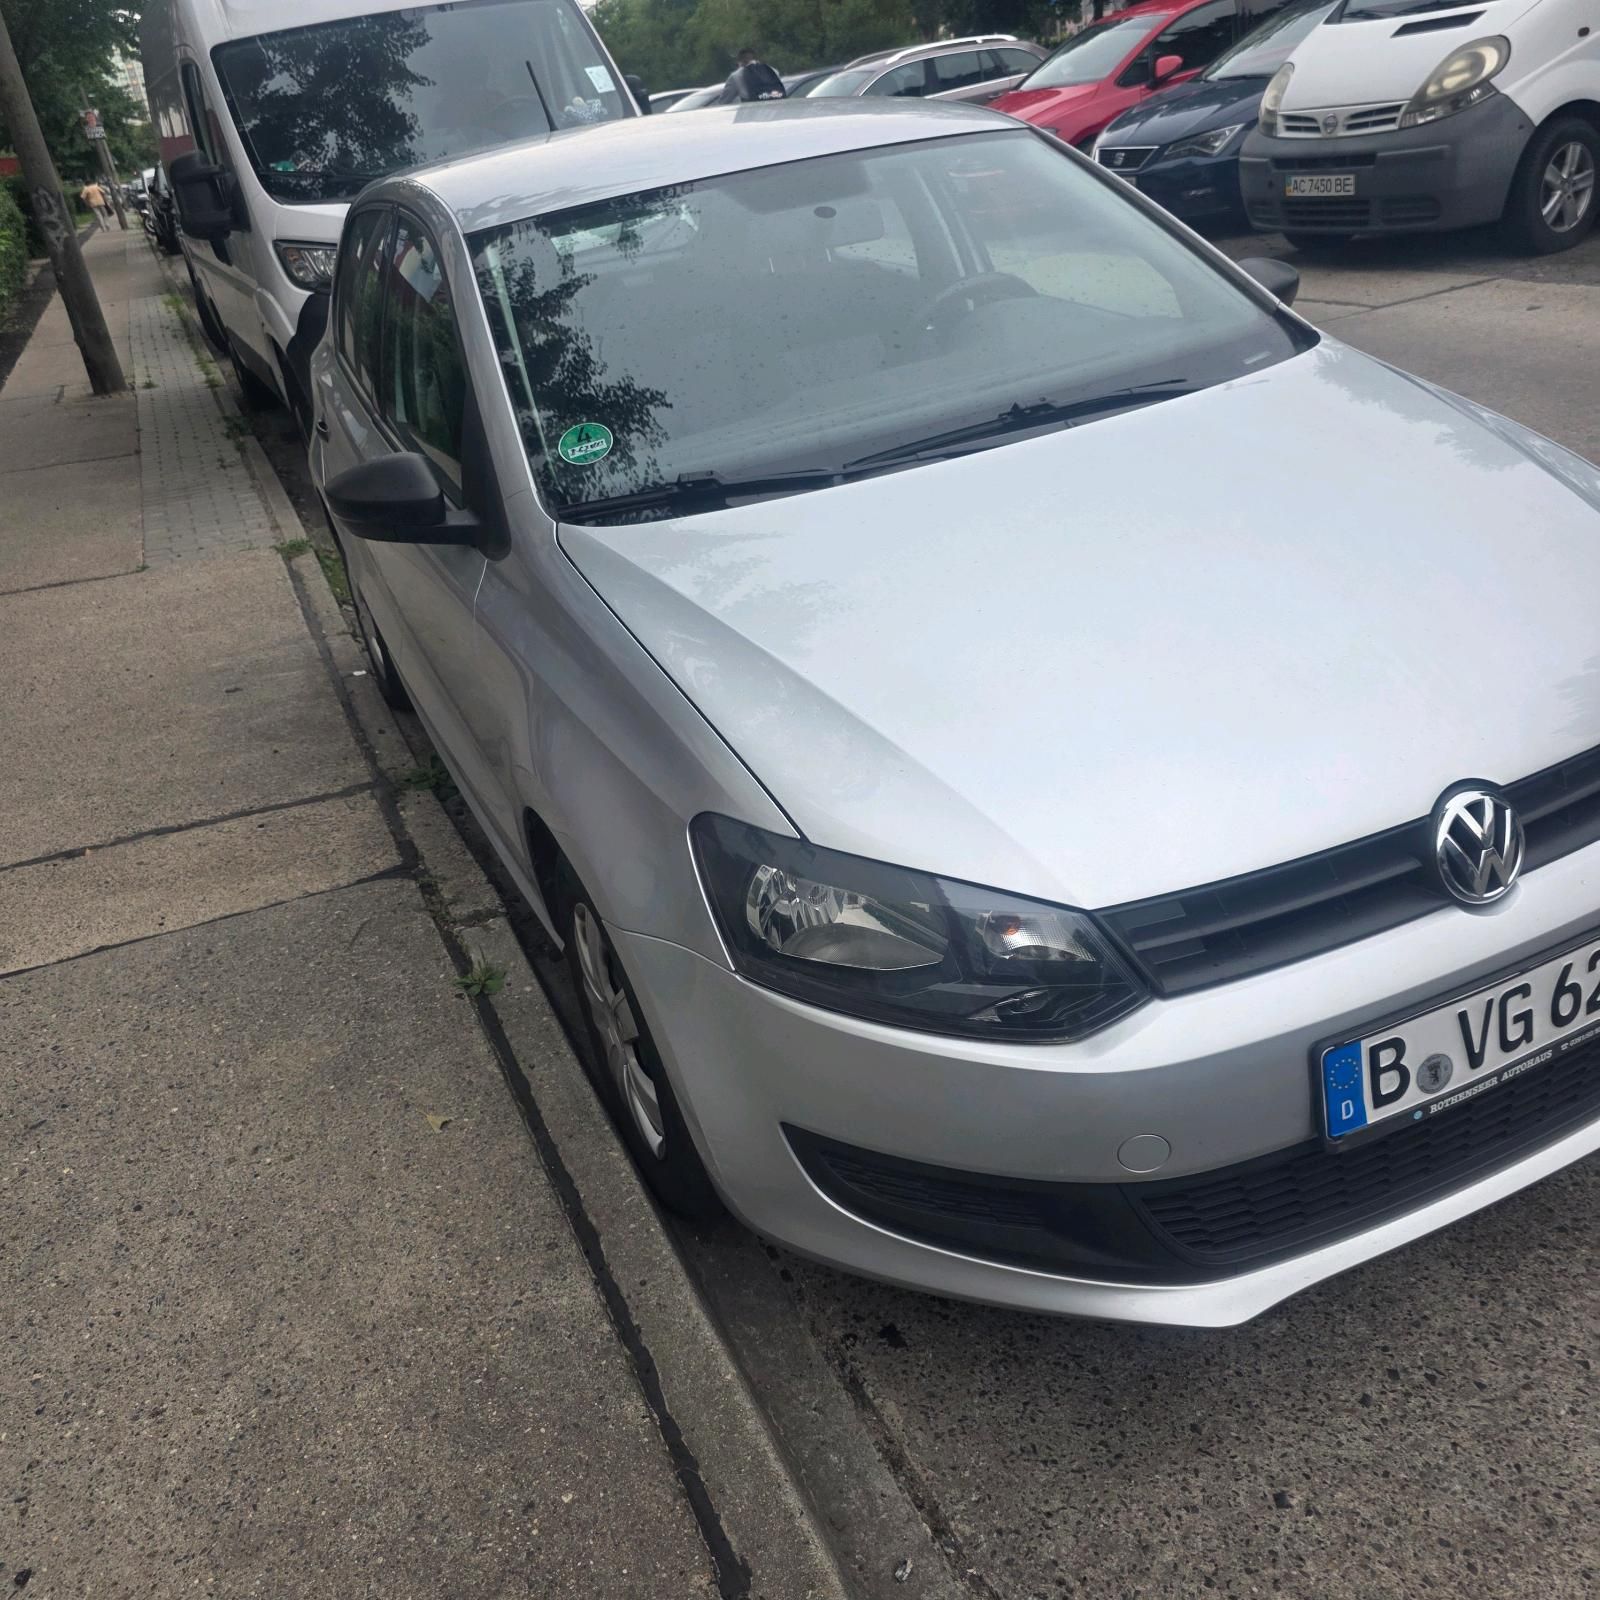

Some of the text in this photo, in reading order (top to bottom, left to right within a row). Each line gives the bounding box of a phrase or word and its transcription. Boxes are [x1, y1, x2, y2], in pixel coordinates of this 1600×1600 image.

[1293, 178, 1353, 193] AC 7450 BE
[577, 427, 592, 443] 4
[1368, 1037, 1411, 1110] B
[1457, 983, 1534, 1070] VG
[1430, 1050, 1553, 1114] ROTHENSEER AUTOHAUS
[1341, 1100, 1354, 1120] D
